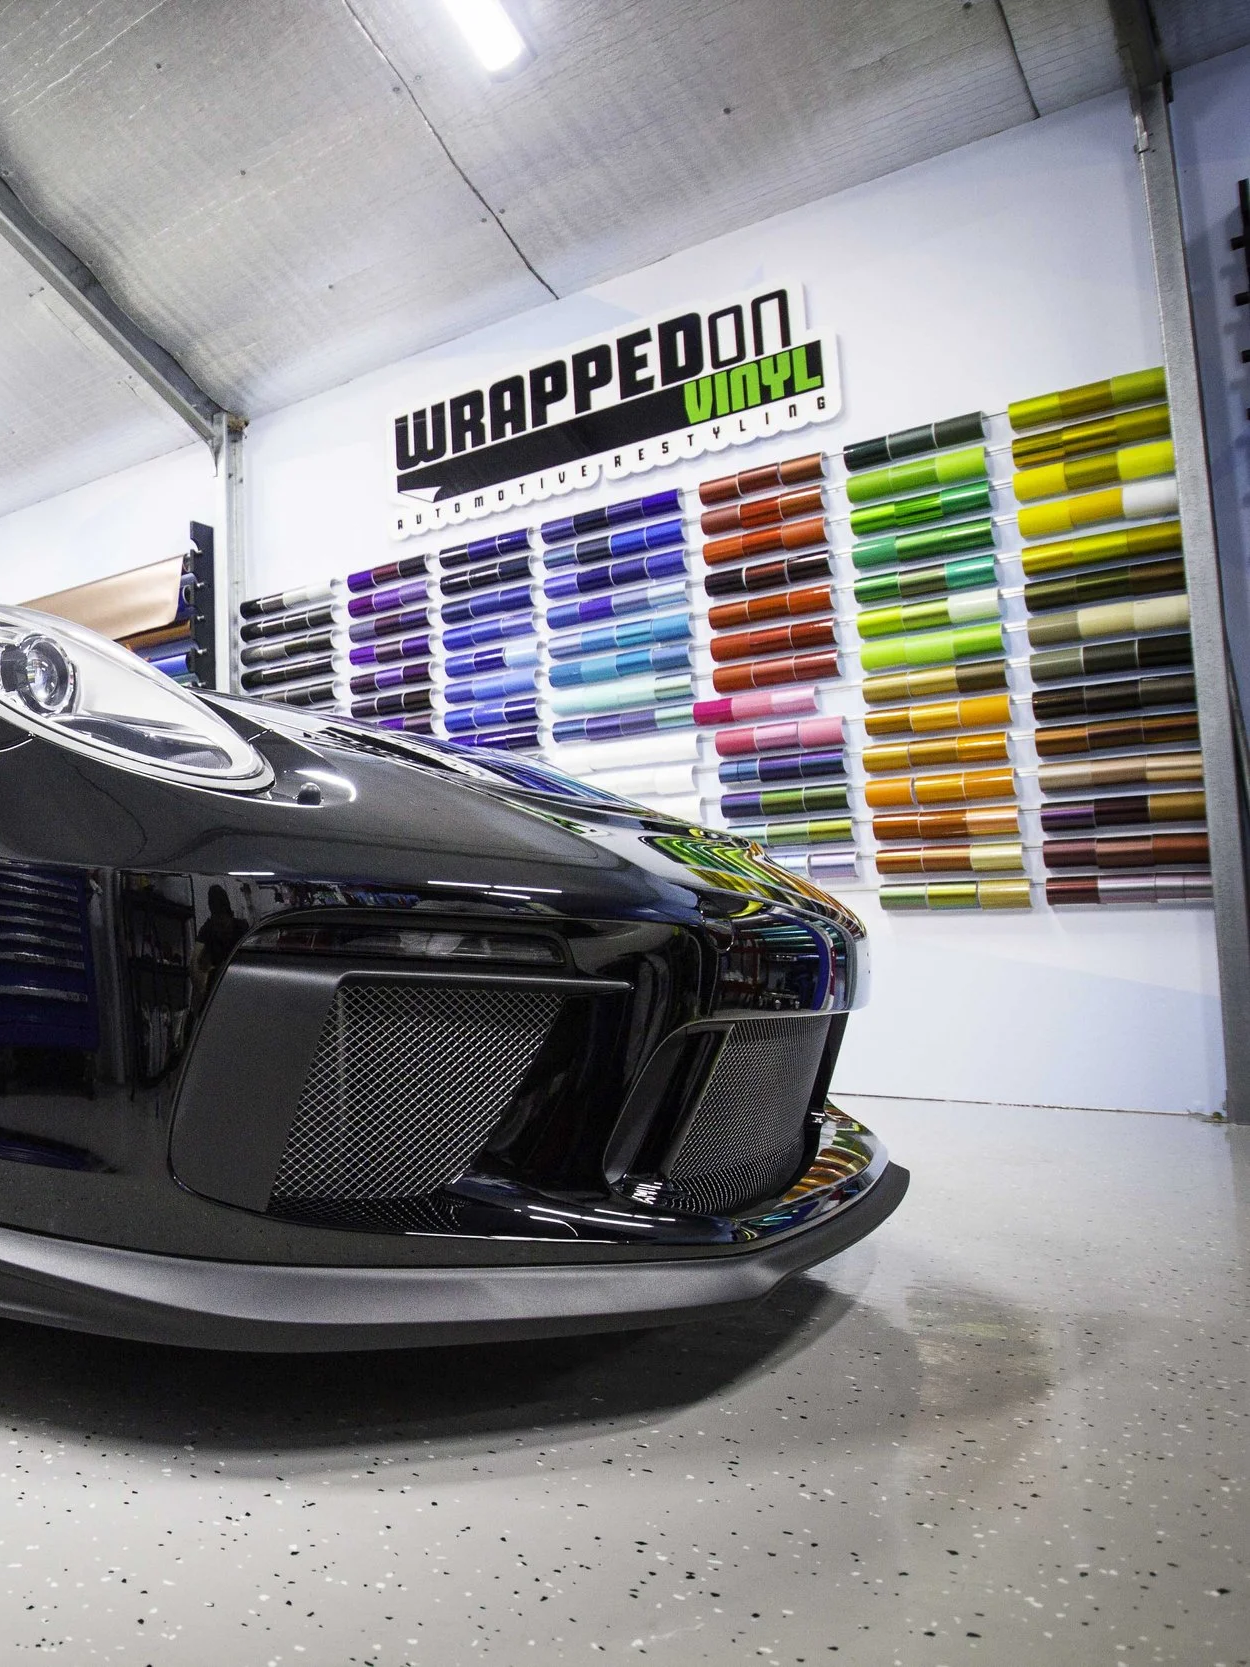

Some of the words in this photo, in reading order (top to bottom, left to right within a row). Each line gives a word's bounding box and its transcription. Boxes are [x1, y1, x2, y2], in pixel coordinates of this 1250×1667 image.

[684, 345, 822, 424] VINYL
[397, 465, 588, 531] AUTOMOTIVE
[614, 396, 827, 468] RESTYLING
